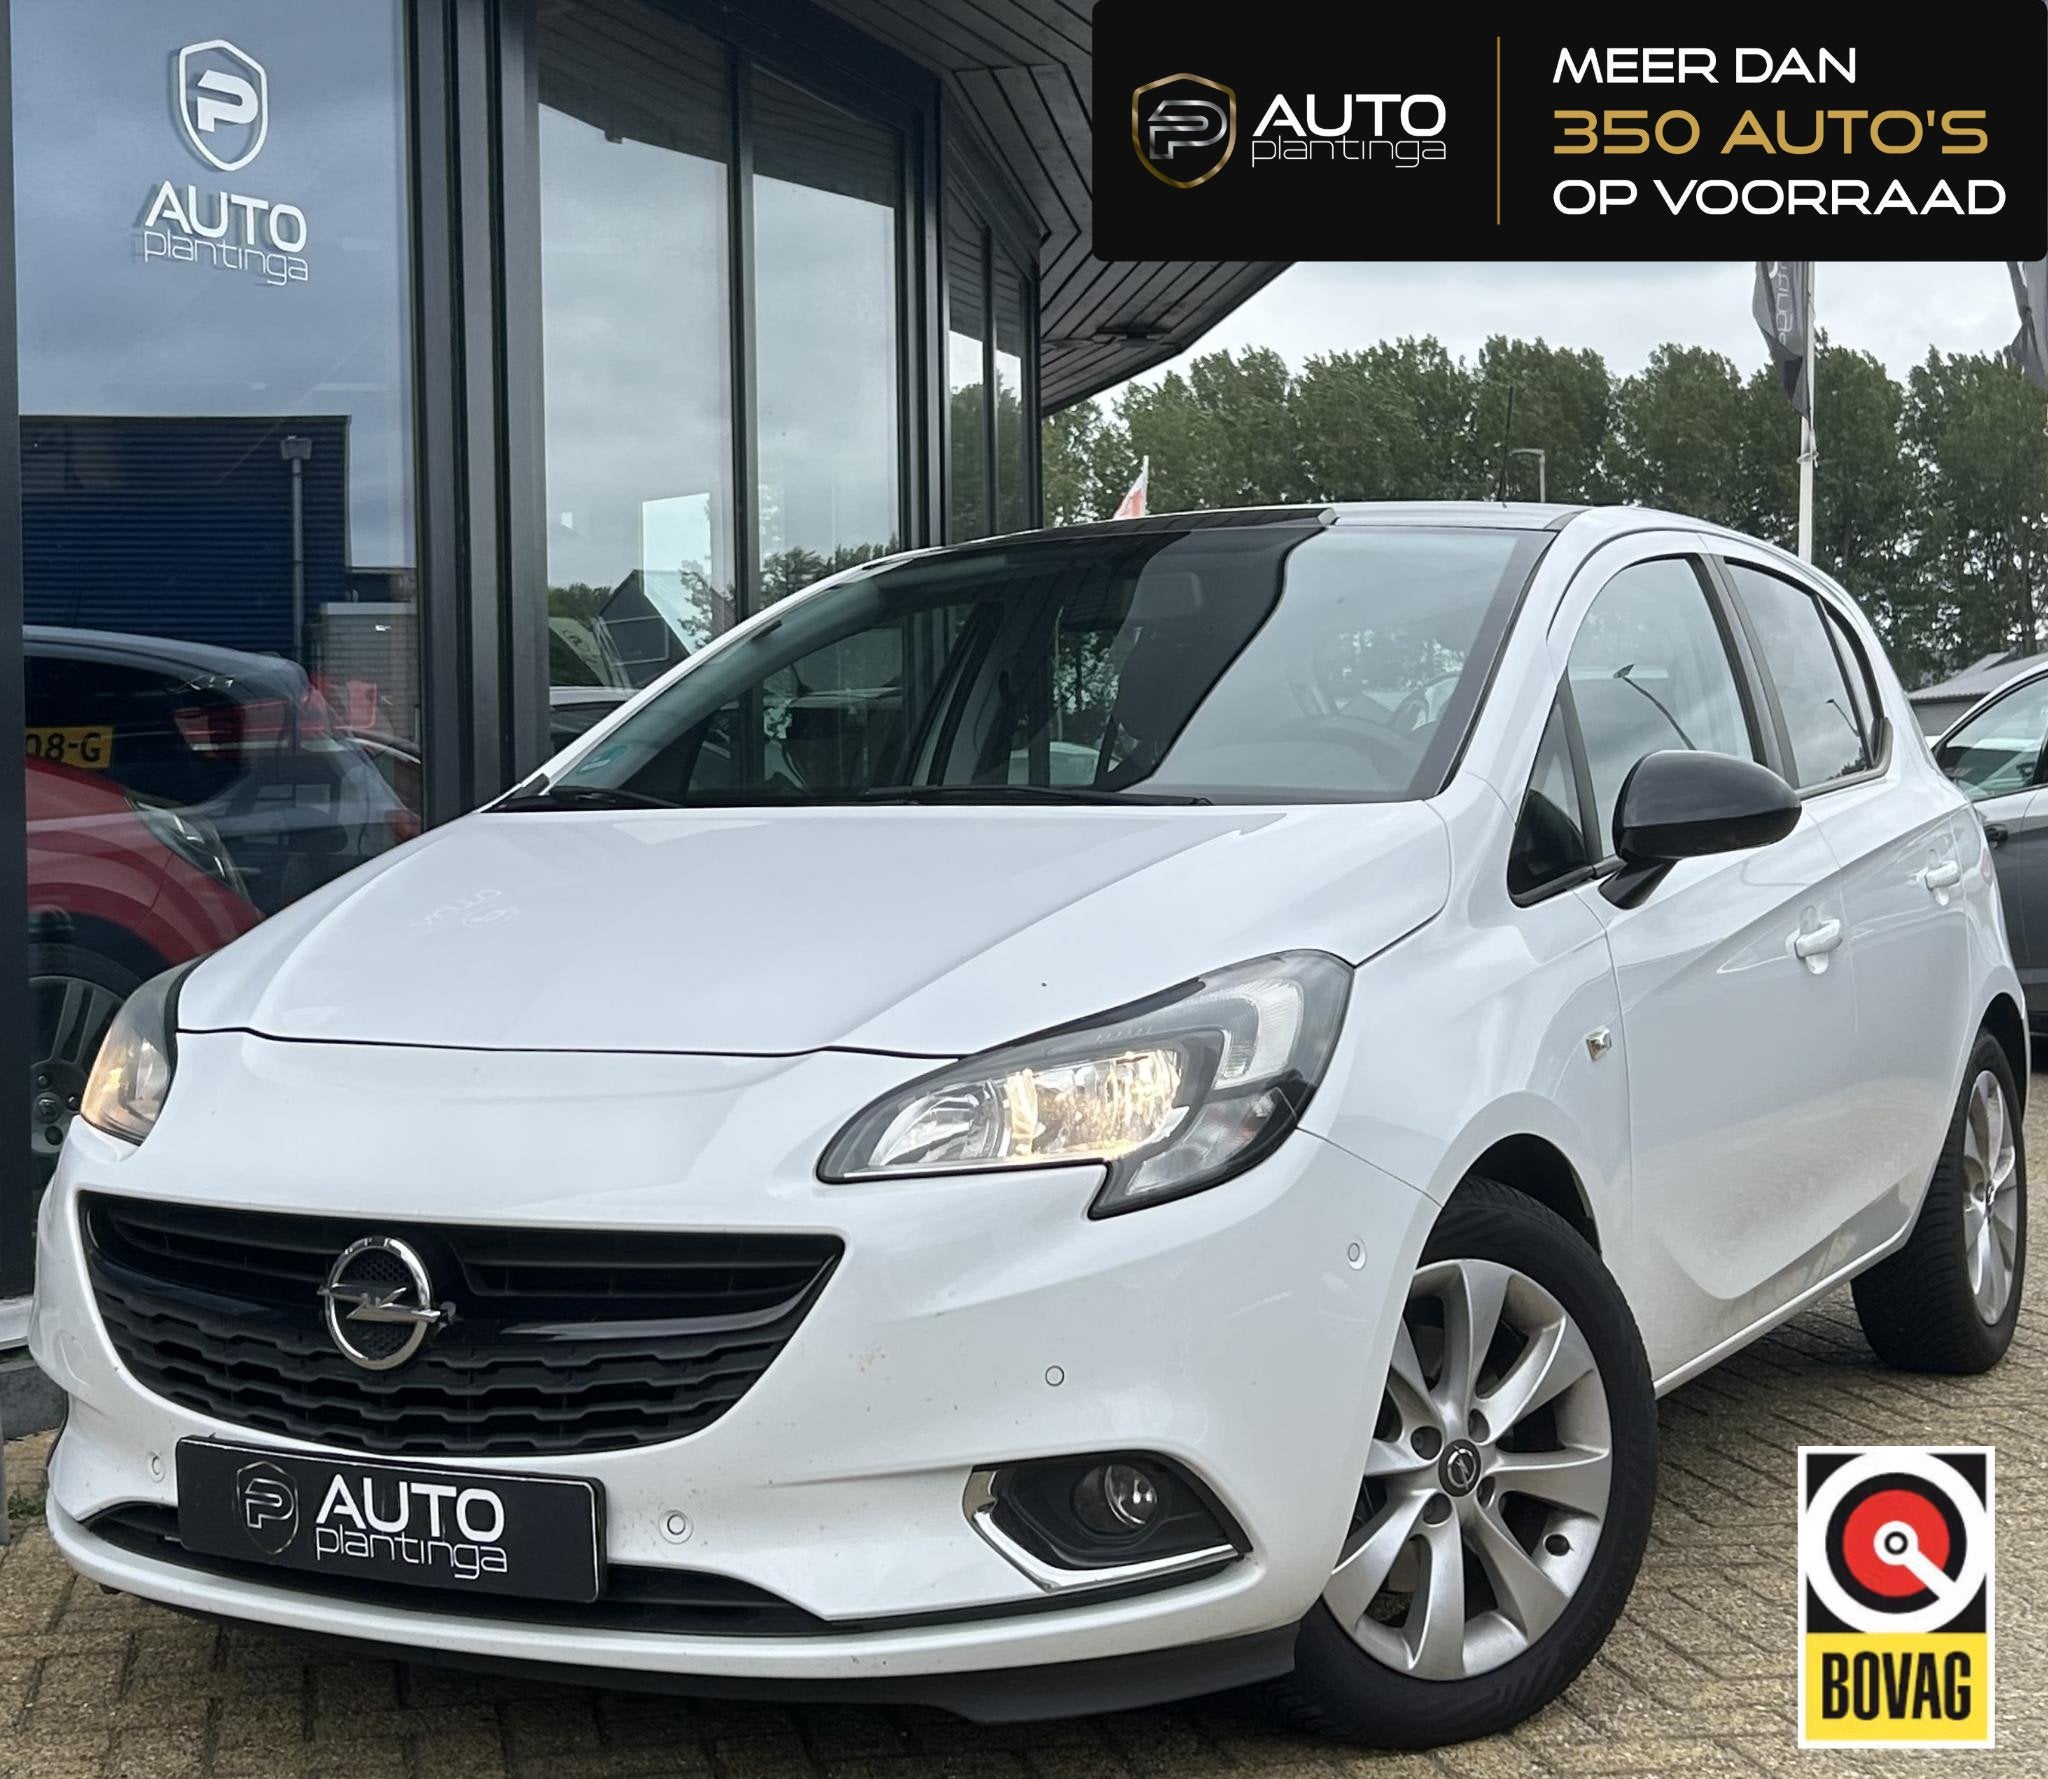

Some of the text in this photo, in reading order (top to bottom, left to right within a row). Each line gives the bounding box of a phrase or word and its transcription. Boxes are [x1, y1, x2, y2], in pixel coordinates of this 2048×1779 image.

[145, 180, 307, 253] AUTO
[144, 229, 309, 286] plantinga
[315, 1473, 505, 1543] AUTO
[315, 1525, 508, 1579] plantinga
